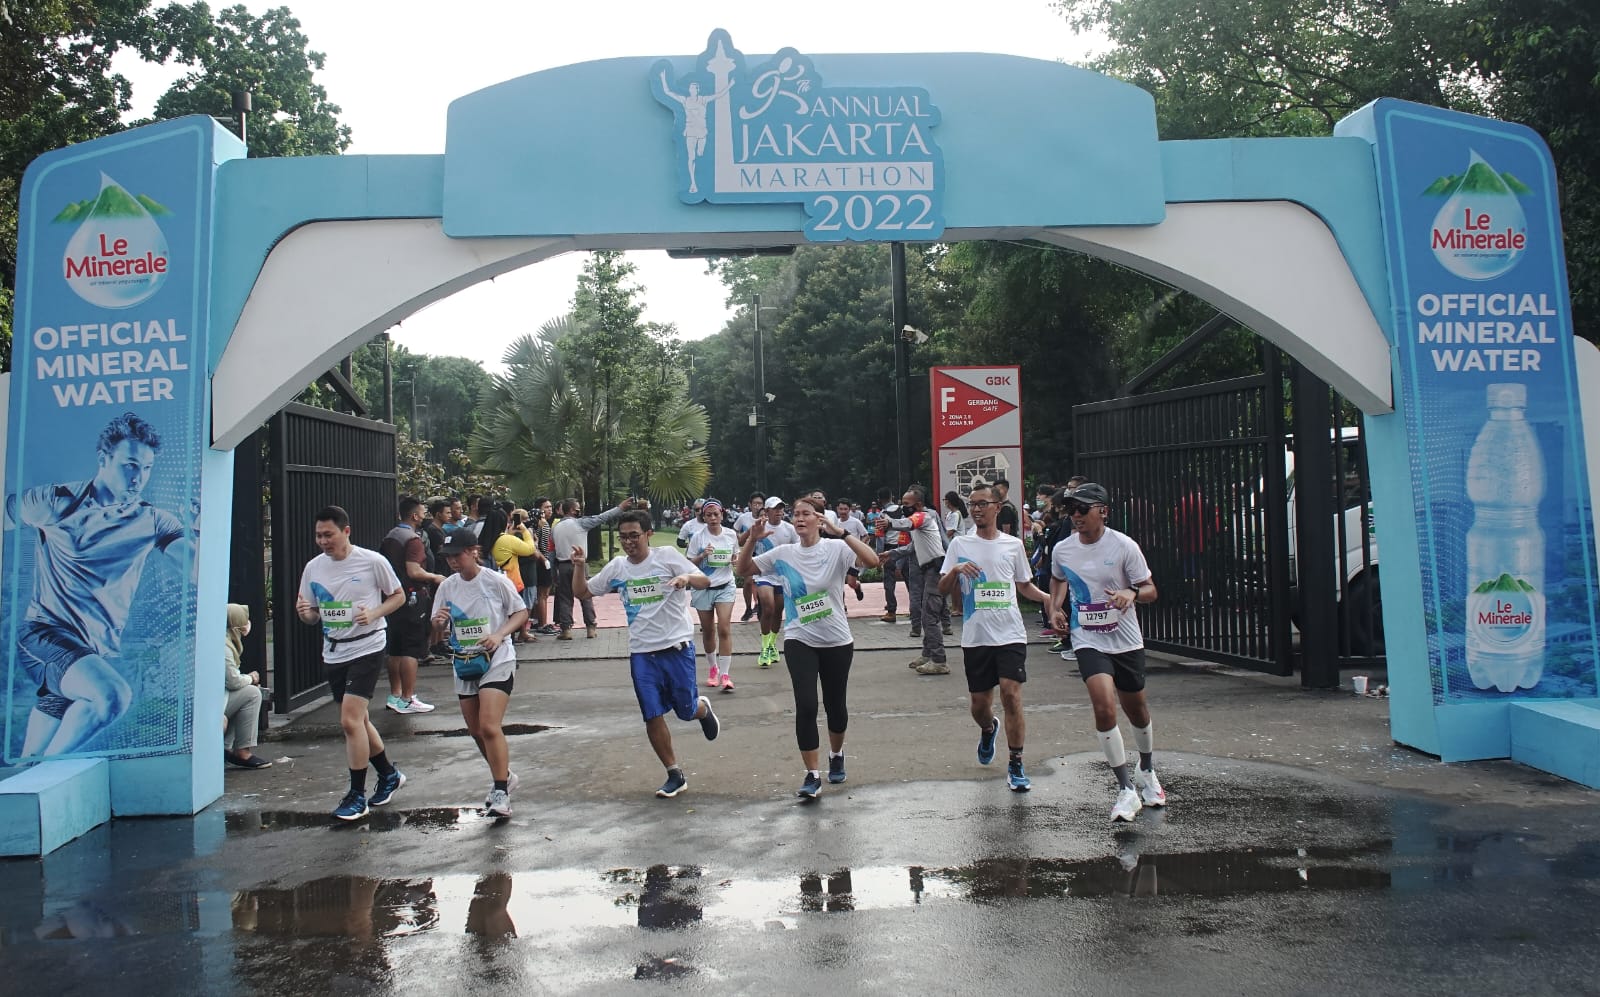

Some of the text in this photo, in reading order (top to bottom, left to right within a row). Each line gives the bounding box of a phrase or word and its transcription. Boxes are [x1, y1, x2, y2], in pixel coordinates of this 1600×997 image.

[810, 96, 930, 118] ANNUAL
[739, 122, 932, 163] JAKARTA
[740, 167, 925, 188] MARATHON
[813, 194, 934, 231] 2022
[1465, 208, 1490, 230] Le
[99, 234, 128, 257] Le
[1432, 228, 1525, 249] Minerale
[65, 252, 167, 278] Minerale
[1417, 293, 1556, 316] OFFICIAL
[33, 319, 186, 350] OFFICIAL
[1418, 321, 1555, 344] MINERAL
[36, 347, 188, 380] MINERAL
[1431, 349, 1541, 371] WATER
[985, 376, 1012, 386] GBK
[52, 377, 175, 408] WATER
[941, 387, 956, 413] F
[633, 585, 656, 594] 54372
[800, 599, 825, 612] 54256
[1085, 612, 1108, 621] 12797
[1497, 599, 1512, 613] Le
[1478, 611, 1532, 625] Minerale
[461, 626, 483, 635] 54138
